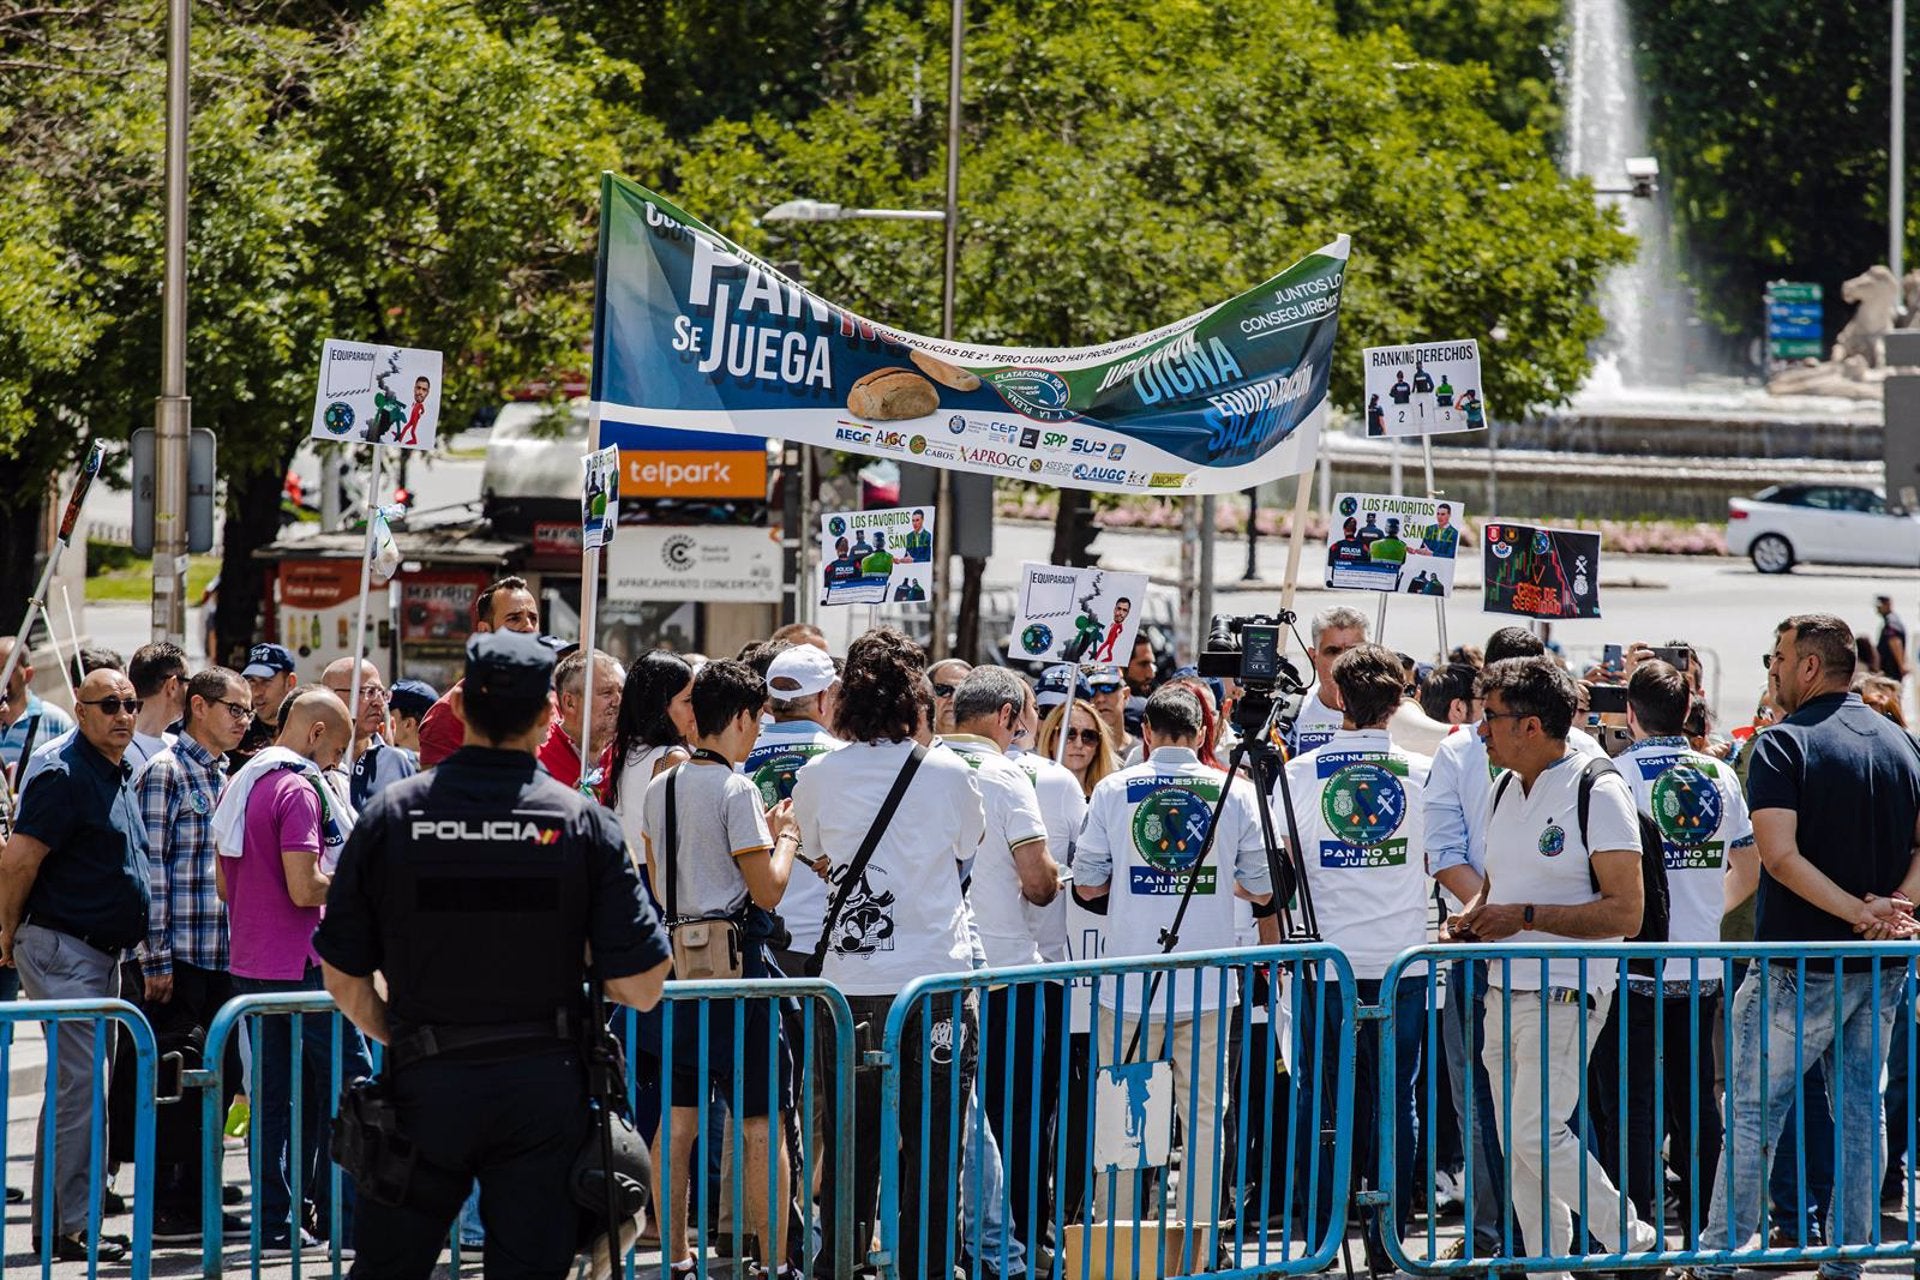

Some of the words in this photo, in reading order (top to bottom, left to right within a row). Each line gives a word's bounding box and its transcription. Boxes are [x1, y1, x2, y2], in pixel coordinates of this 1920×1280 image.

[689, 231, 828, 323] PAN
[1275, 278, 1328, 305] JUNTOS
[1328, 273, 1342, 290] LO
[672, 315, 702, 352] SE
[699, 284, 831, 389] JUEGA
[908, 339, 957, 357] POLICÍAS
[959, 350, 975, 360] DE
[992, 354, 1020, 364] PERO
[1023, 354, 1066, 364] CUANDO
[1067, 353, 1087, 363] HAY
[1372, 350, 1415, 367] RANKING
[1417, 345, 1473, 363] DERECHOS
[995, 370, 1050, 381] PLATAFORMA
[1133, 336, 1243, 405] DIGNA
[1398, 411, 1405, 423] 2
[1419, 402, 1424, 418] 1
[1445, 411, 1451, 421] 3
[990, 421, 1018, 434] CEP
[836, 428, 871, 443] AEGC
[1043, 432, 1068, 448] SPP
[1071, 438, 1107, 454] SUP
[924, 448, 954, 460] CABOS
[630, 461, 731, 487] telpark
[1088, 467, 1127, 481] AUGC
[1362, 498, 1380, 511] LOS
[1382, 500, 1436, 516] FAVORITOS
[850, 515, 866, 528] LOS
[868, 512, 910, 527] FAVORITOS
[618, 578, 699, 589] APARCAMIENTO
[748, 747, 771, 758] CON
[1317, 754, 1345, 763] CON
[1344, 764, 1378, 772] PLATAFORMA
[1158, 778, 1219, 786] NUESTRO
[411, 821, 541, 841] POLICIA
[1324, 849, 1356, 857] PAN
[1362, 848, 1383, 857] NO
[1389, 845, 1405, 855] SE
[1664, 851, 1680, 859] AN
[1683, 850, 1703, 858] NO
[1707, 849, 1722, 857] SE
[1340, 857, 1390, 866] JUEGA
[1667, 859, 1707, 868] JUEGA
[1134, 875, 1165, 884] PAN
[1170, 875, 1190, 884] NO
[1197, 875, 1215, 884] SE
[1150, 885, 1198, 893] JUEGA
